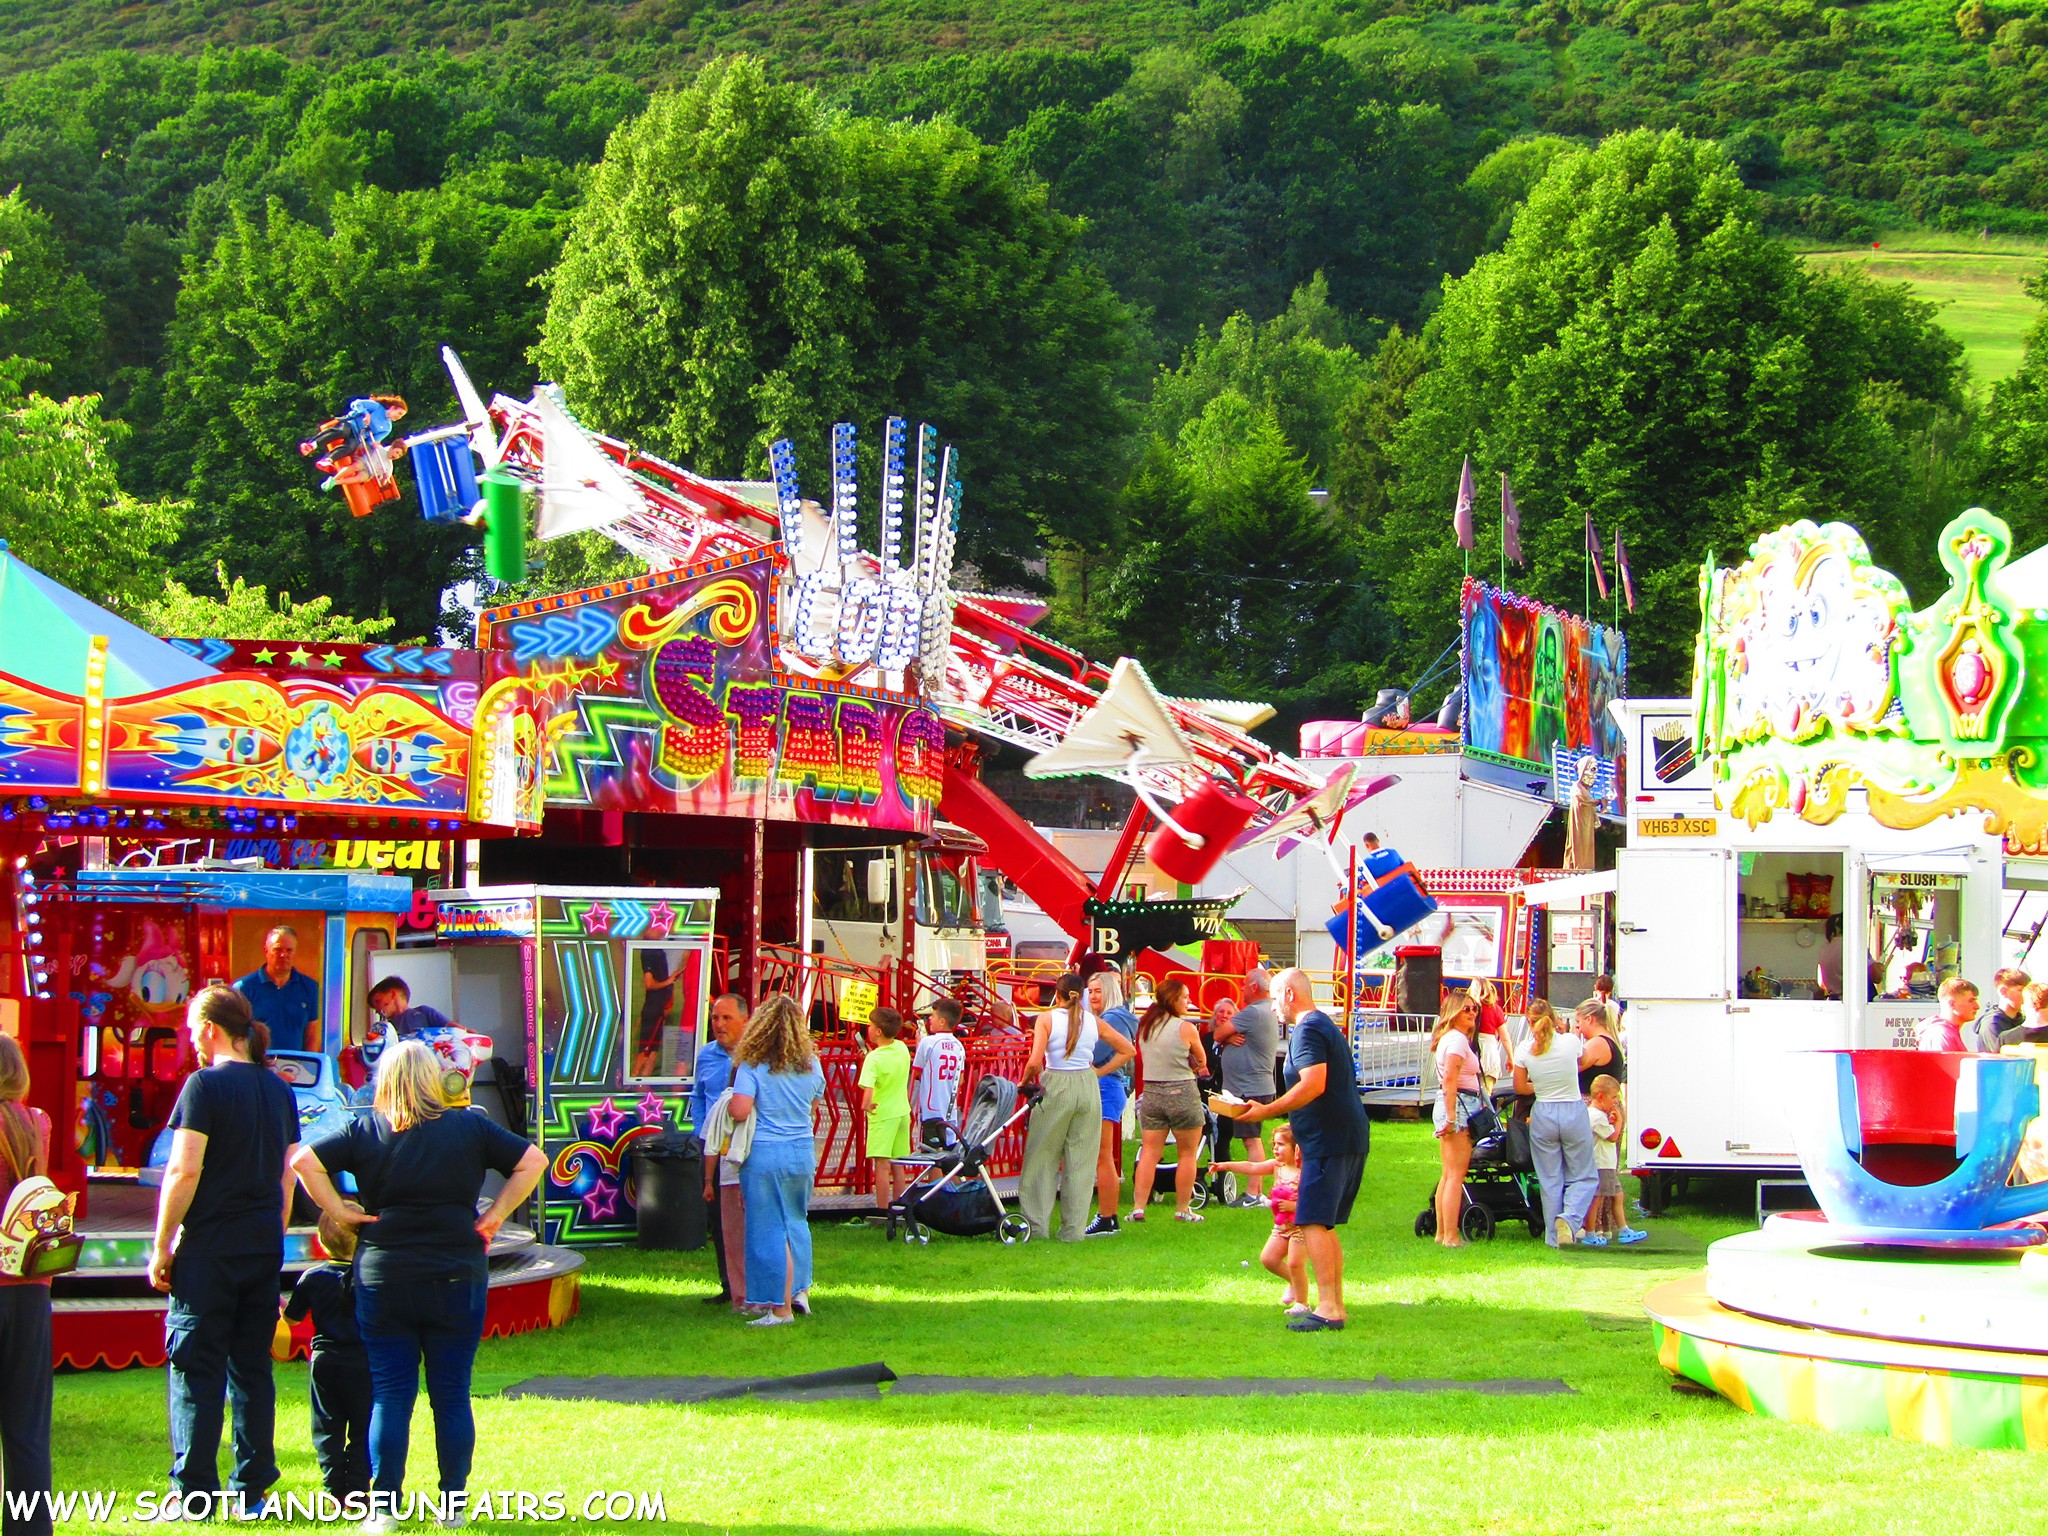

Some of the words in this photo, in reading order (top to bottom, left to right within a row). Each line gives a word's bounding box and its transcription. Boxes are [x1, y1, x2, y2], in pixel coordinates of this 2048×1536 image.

[649, 634, 884, 802] STAR
[1643, 820, 1679, 834] YH63
[1683, 820, 1710, 833] XSC
[333, 839, 441, 870] beat
[1900, 873, 1937, 886] SLUSH
[1192, 916, 1225, 935] WIN
[1885, 1017, 1915, 1028] NEW
